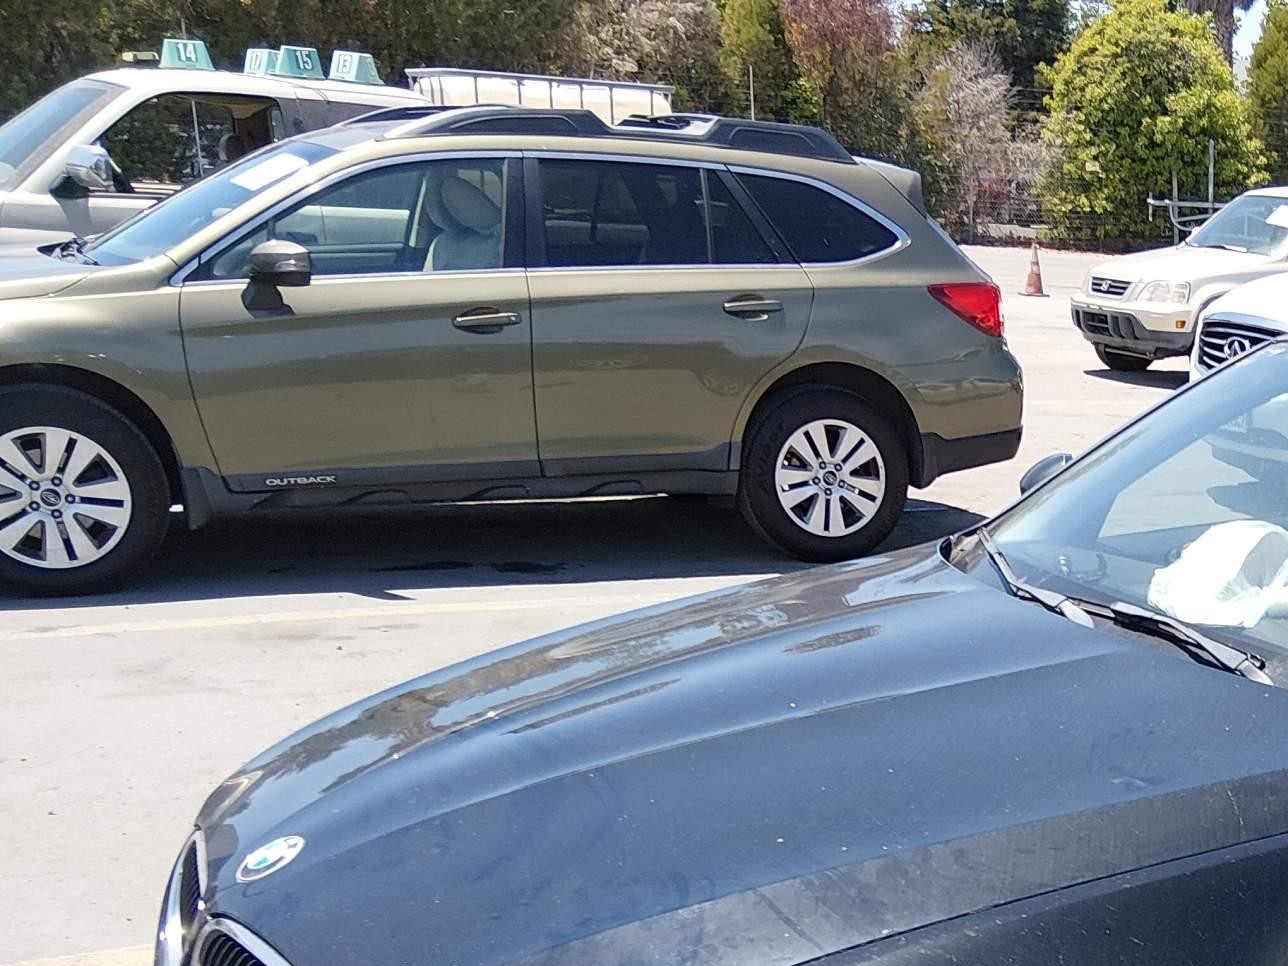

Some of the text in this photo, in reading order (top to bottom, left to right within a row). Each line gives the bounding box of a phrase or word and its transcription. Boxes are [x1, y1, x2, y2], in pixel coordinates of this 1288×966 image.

[177, 43, 196, 61] 14
[249, 51, 262, 70] 17
[295, 50, 313, 70] 15
[337, 54, 352, 73] 13
[265, 475, 337, 486] OUTBACK
